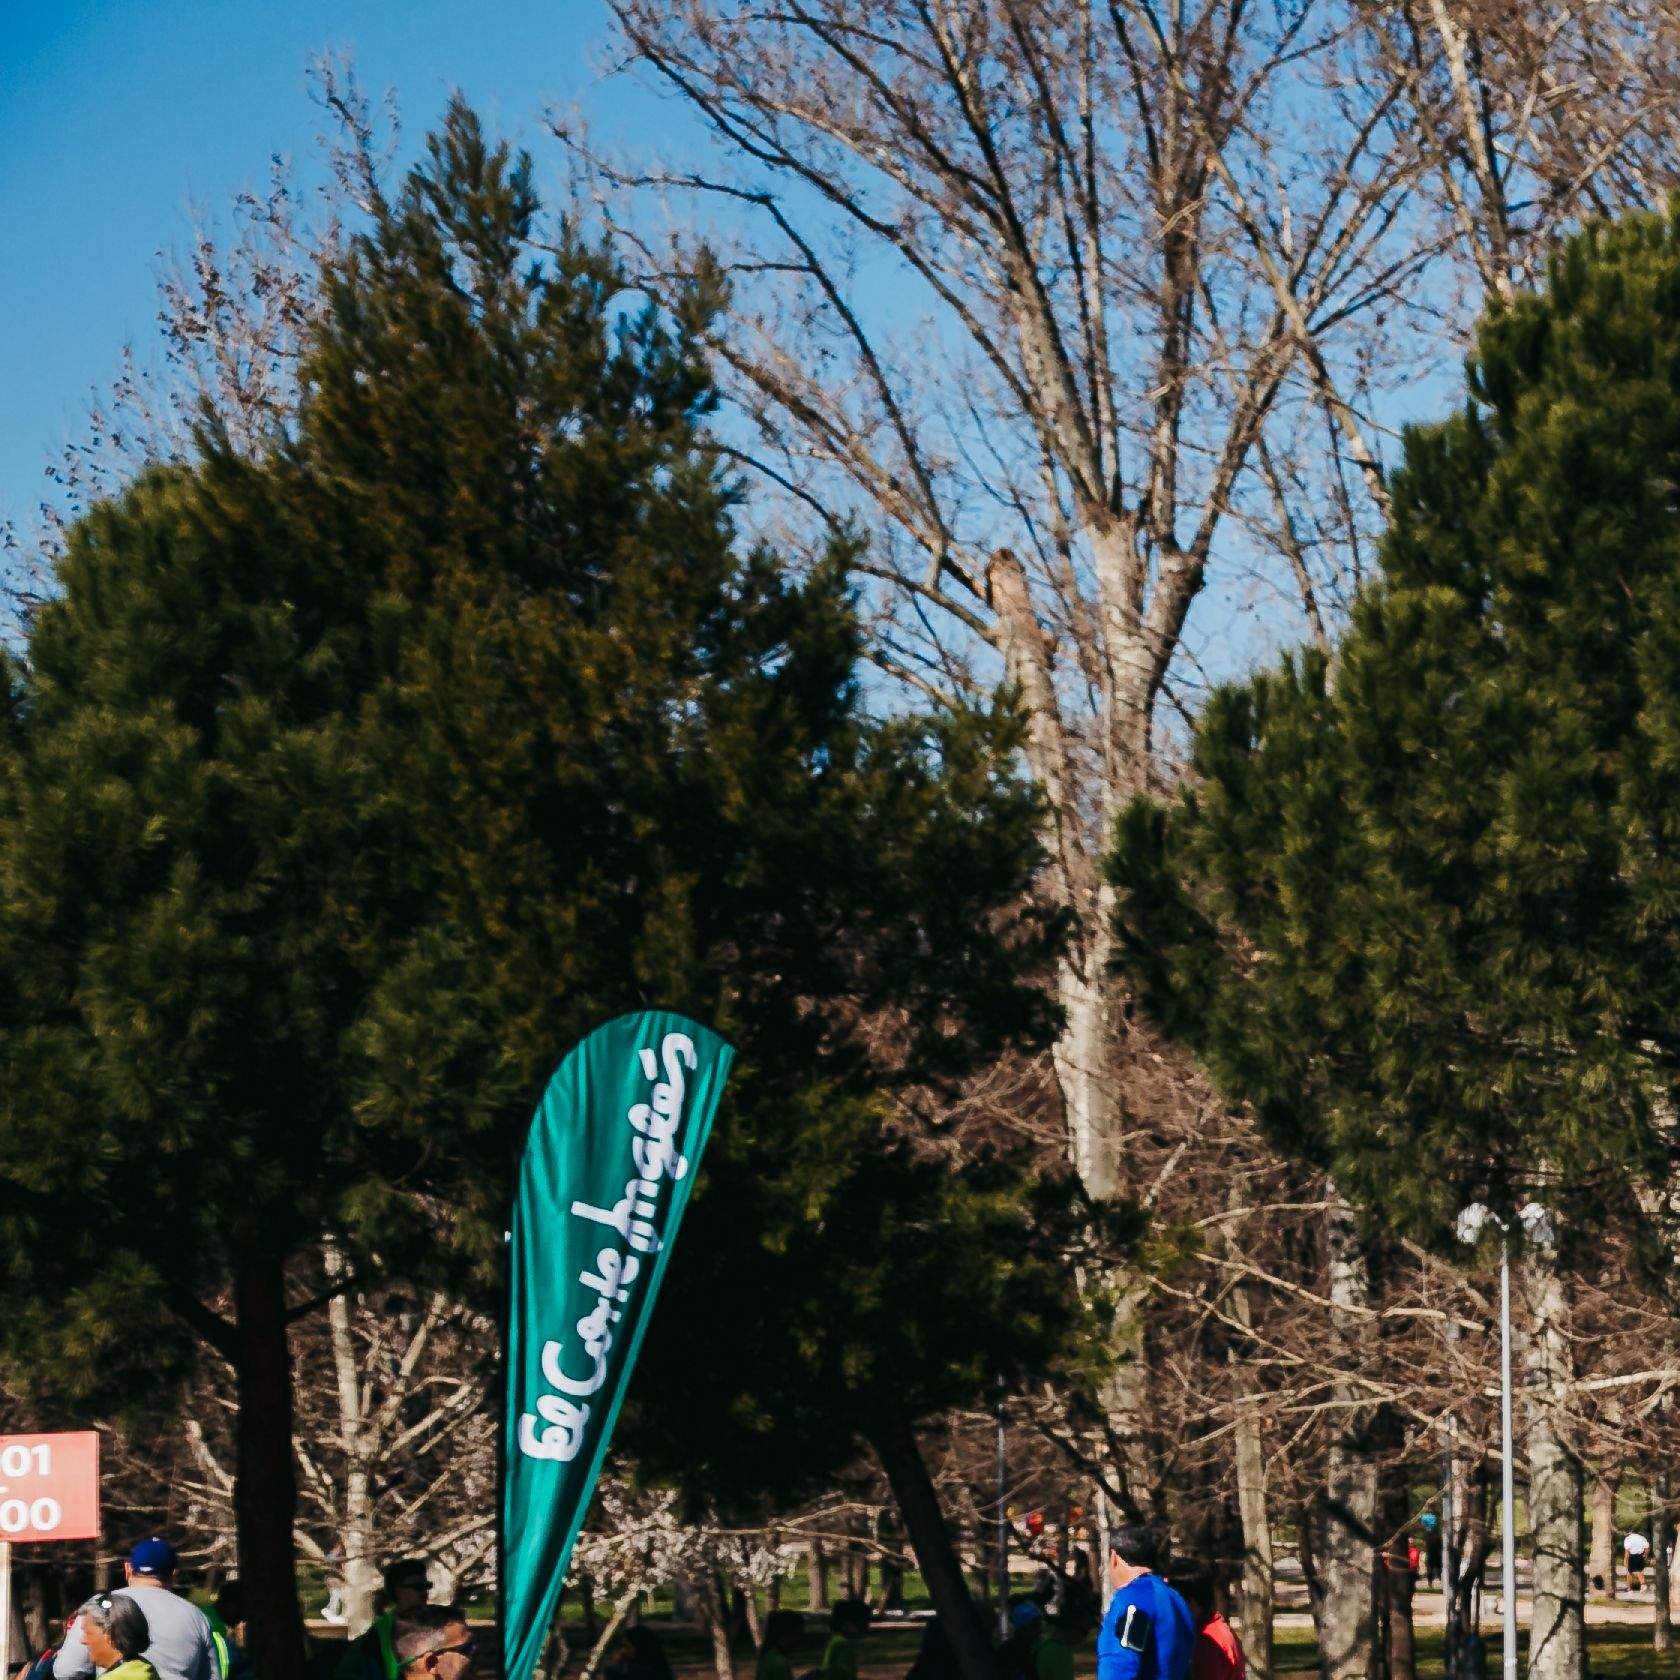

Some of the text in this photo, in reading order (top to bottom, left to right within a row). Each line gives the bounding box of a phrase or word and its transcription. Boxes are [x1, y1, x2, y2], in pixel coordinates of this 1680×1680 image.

[519, 1032, 698, 1462] El Corte Inglés
